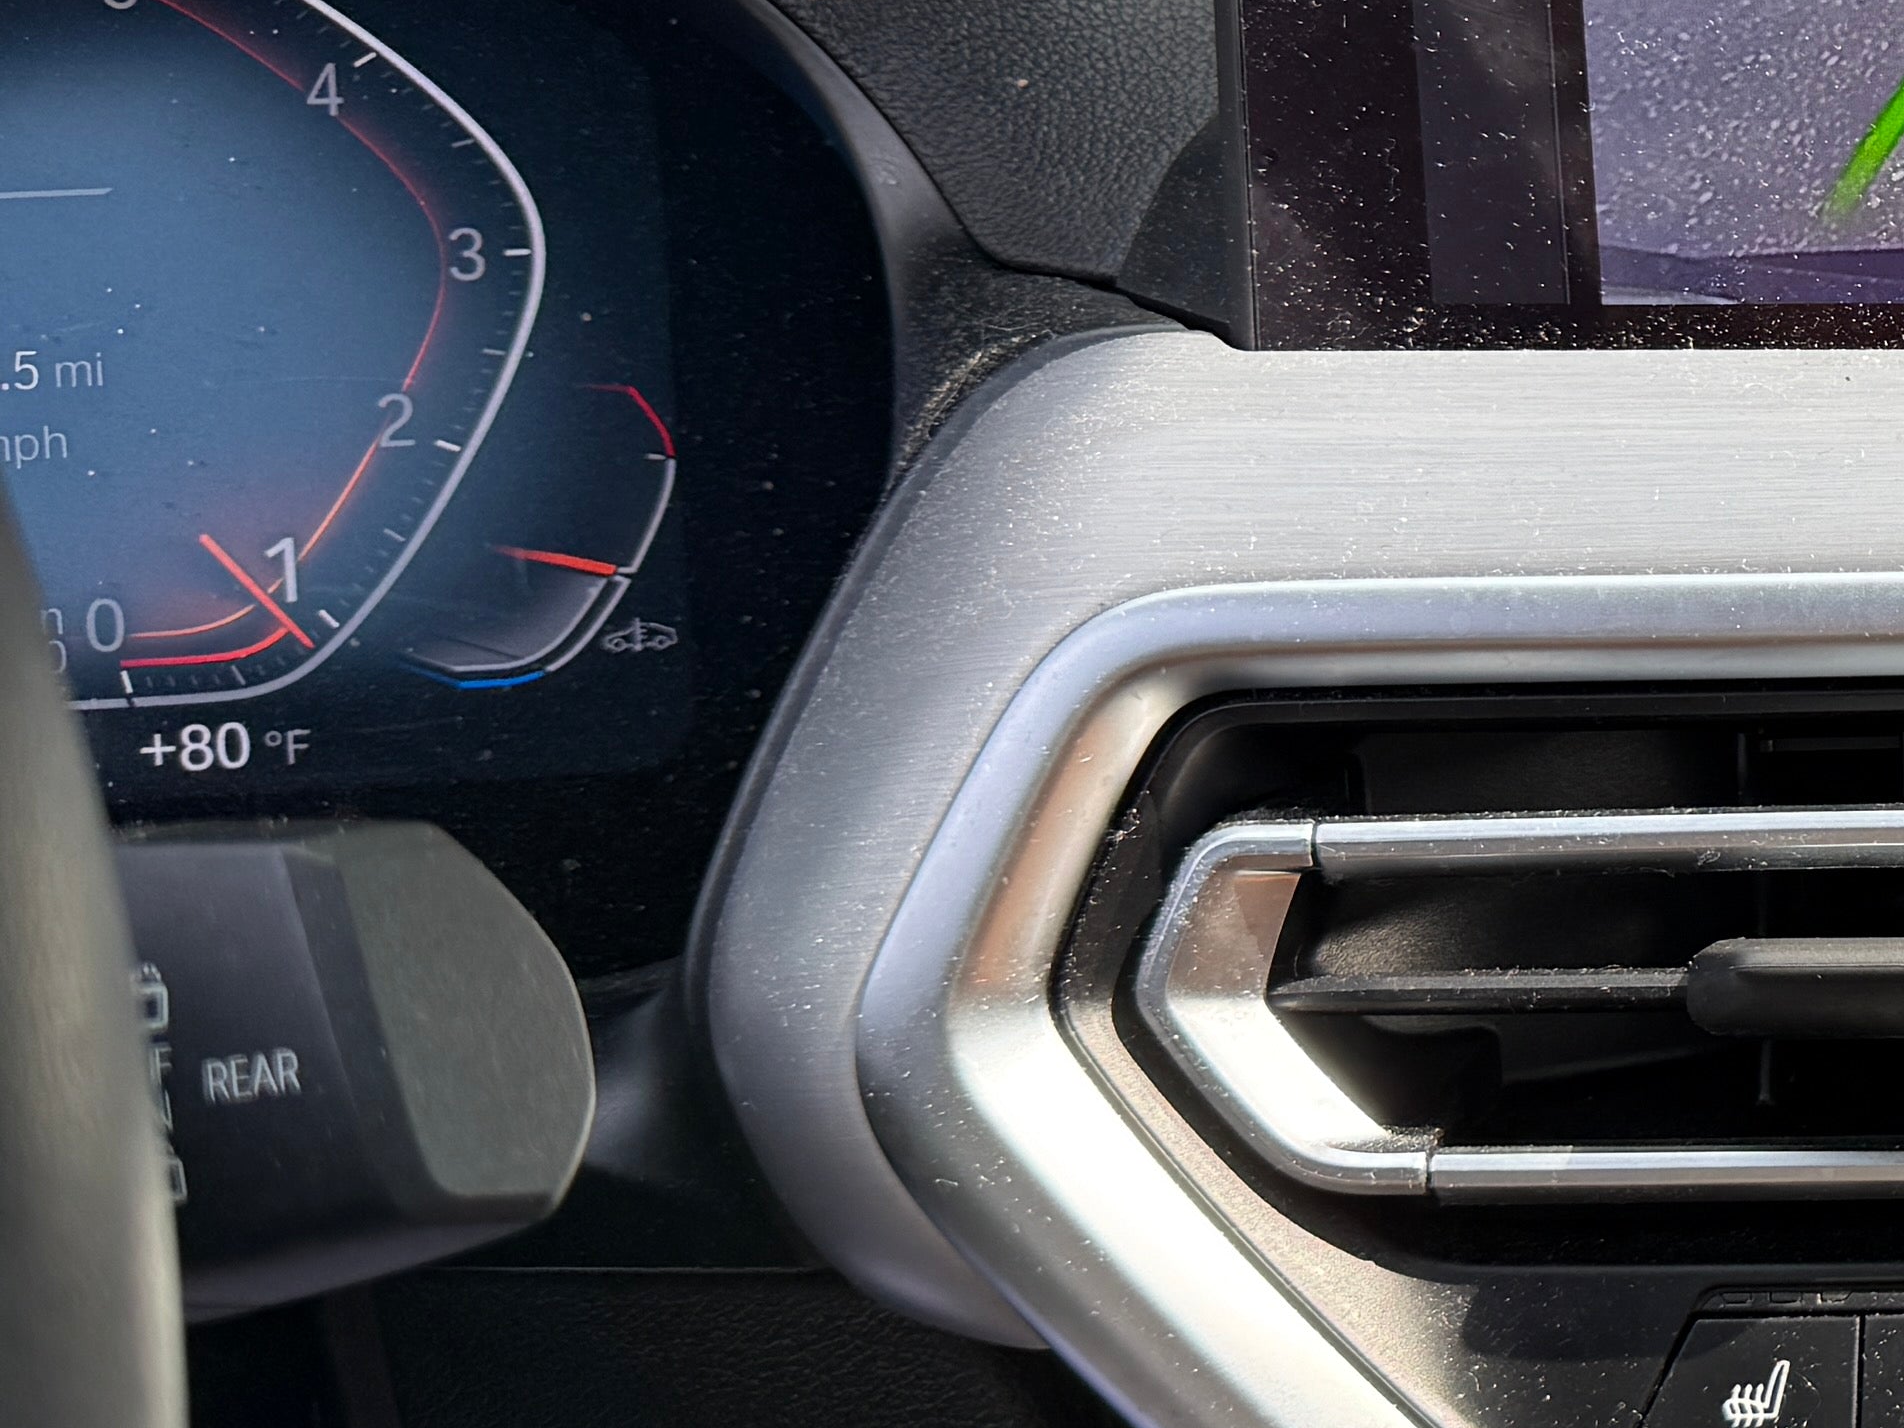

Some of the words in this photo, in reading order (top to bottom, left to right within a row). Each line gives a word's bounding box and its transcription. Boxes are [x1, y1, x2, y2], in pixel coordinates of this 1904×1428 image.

[306, 62, 344, 116] 4
[449, 227, 486, 281] 3
[55, 351, 104, 388] mi
[377, 393, 416, 448] 2
[265, 537, 300, 603] 1
[86, 598, 125, 653] 0
[139, 722, 251, 771] +80
[264, 728, 312, 766] °F
[202, 1046, 301, 1105] REAR
